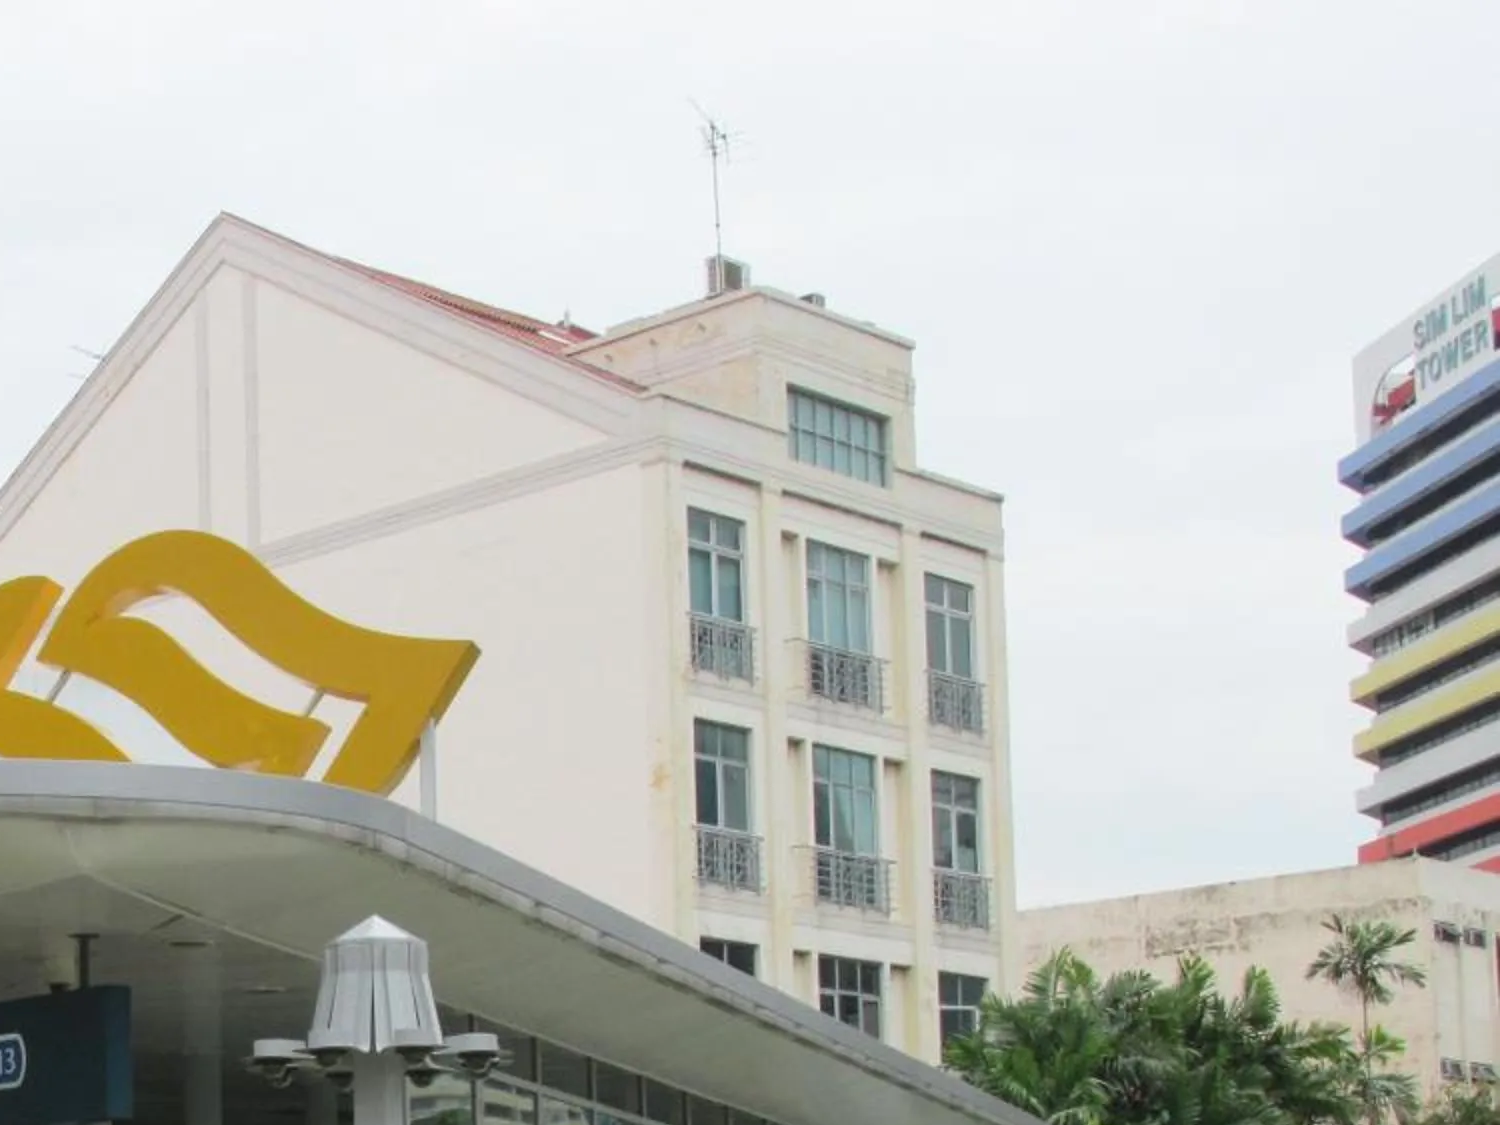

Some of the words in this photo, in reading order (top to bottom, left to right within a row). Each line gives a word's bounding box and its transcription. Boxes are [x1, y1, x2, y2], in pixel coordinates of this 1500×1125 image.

[1413, 303, 1447, 349] SIM
[1451, 275, 1486, 325] LIM
[1416, 319, 1489, 391] TOWER
